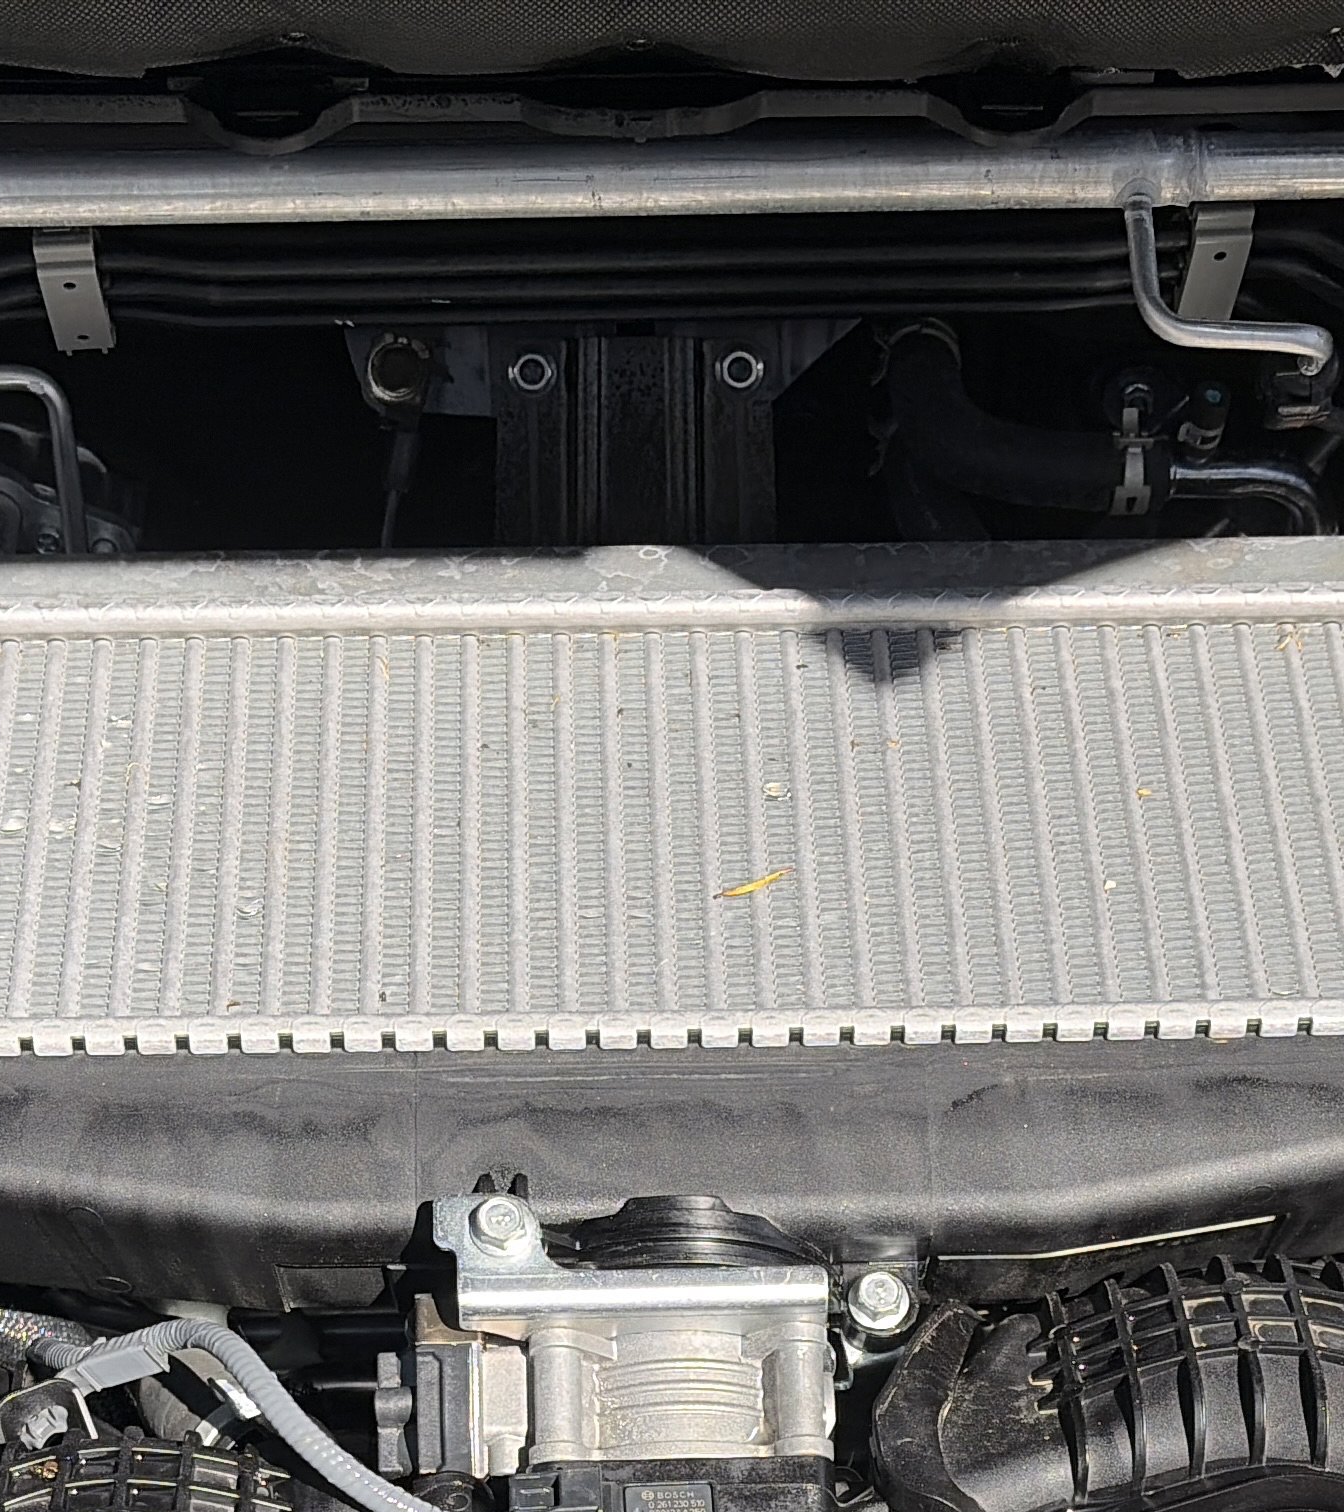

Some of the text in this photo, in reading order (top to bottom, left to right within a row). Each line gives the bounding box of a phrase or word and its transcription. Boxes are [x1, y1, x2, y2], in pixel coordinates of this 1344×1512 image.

[656, 1491, 695, 1499] BOSCH
[657, 1500, 671, 1509] 261
[673, 1500, 689, 1508] 230
[691, 1499, 705, 1508] 510
